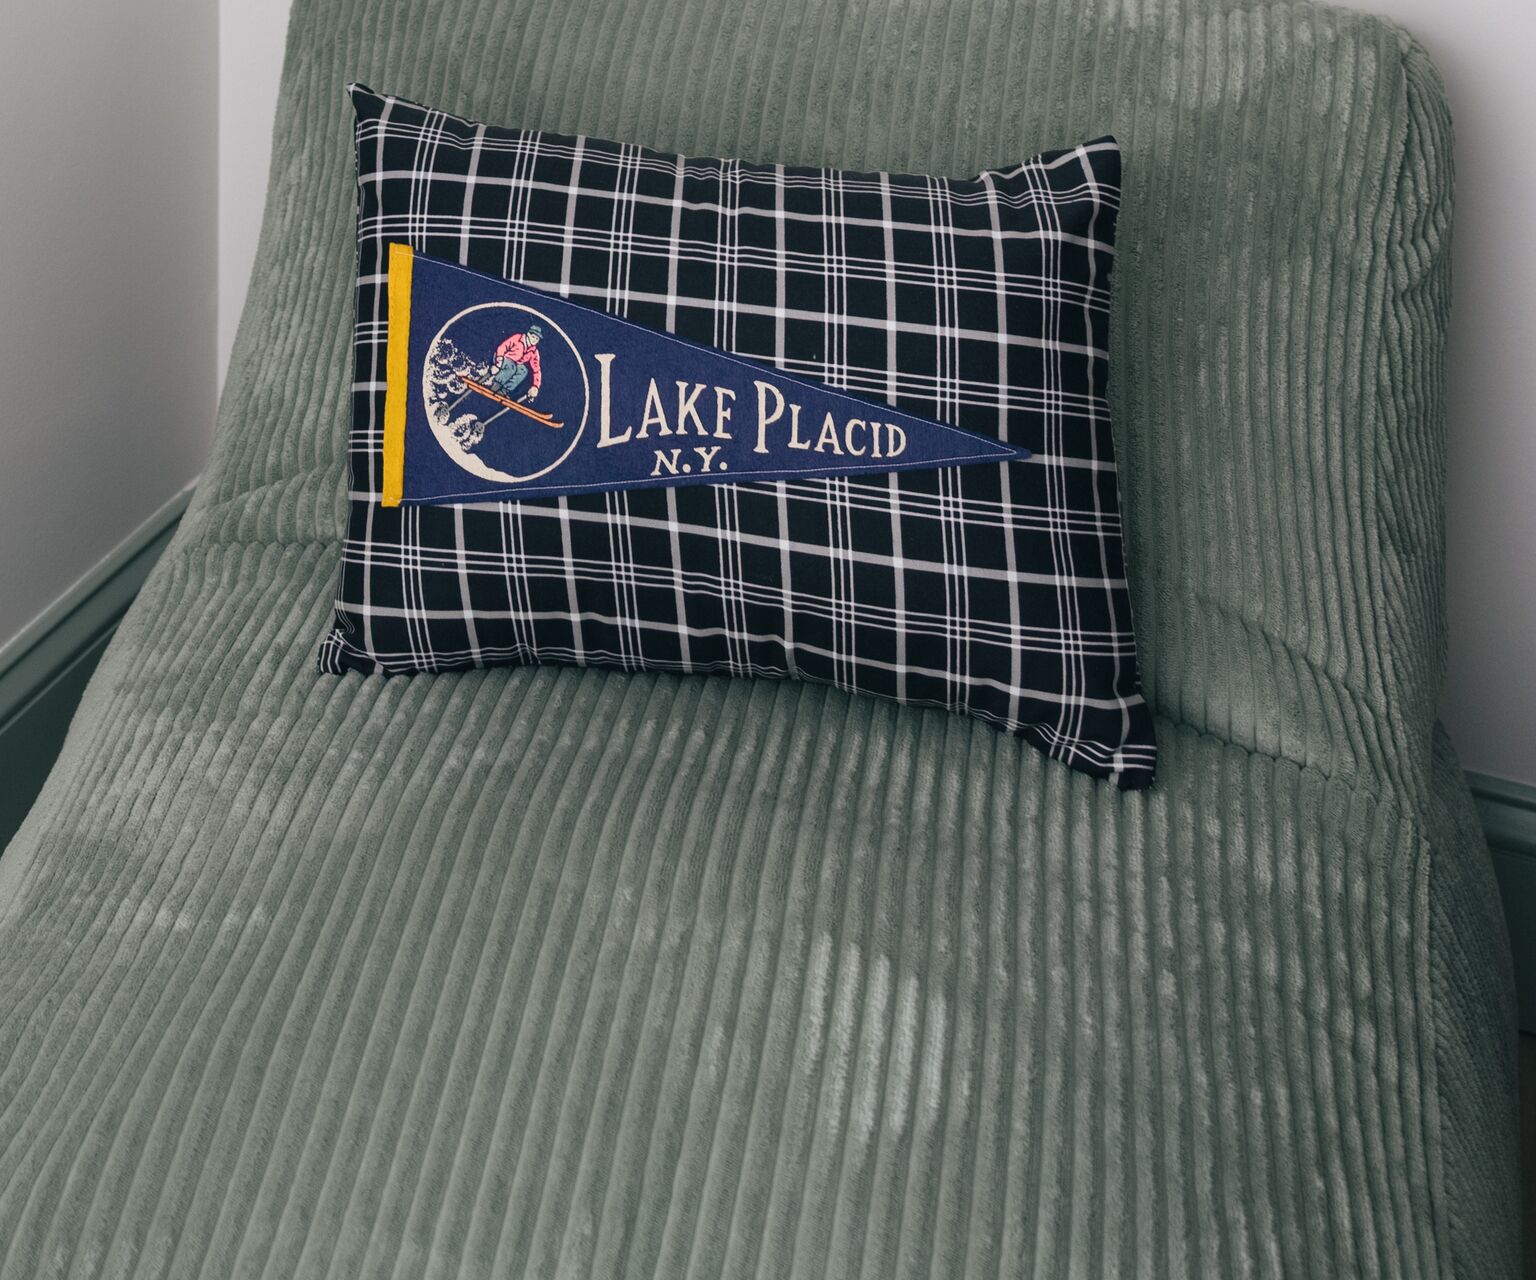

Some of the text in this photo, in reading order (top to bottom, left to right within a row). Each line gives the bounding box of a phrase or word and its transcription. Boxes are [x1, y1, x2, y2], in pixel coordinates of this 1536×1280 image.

[594, 353, 907, 459] LAKE PLACID
[650, 446, 729, 477] N.Y.
